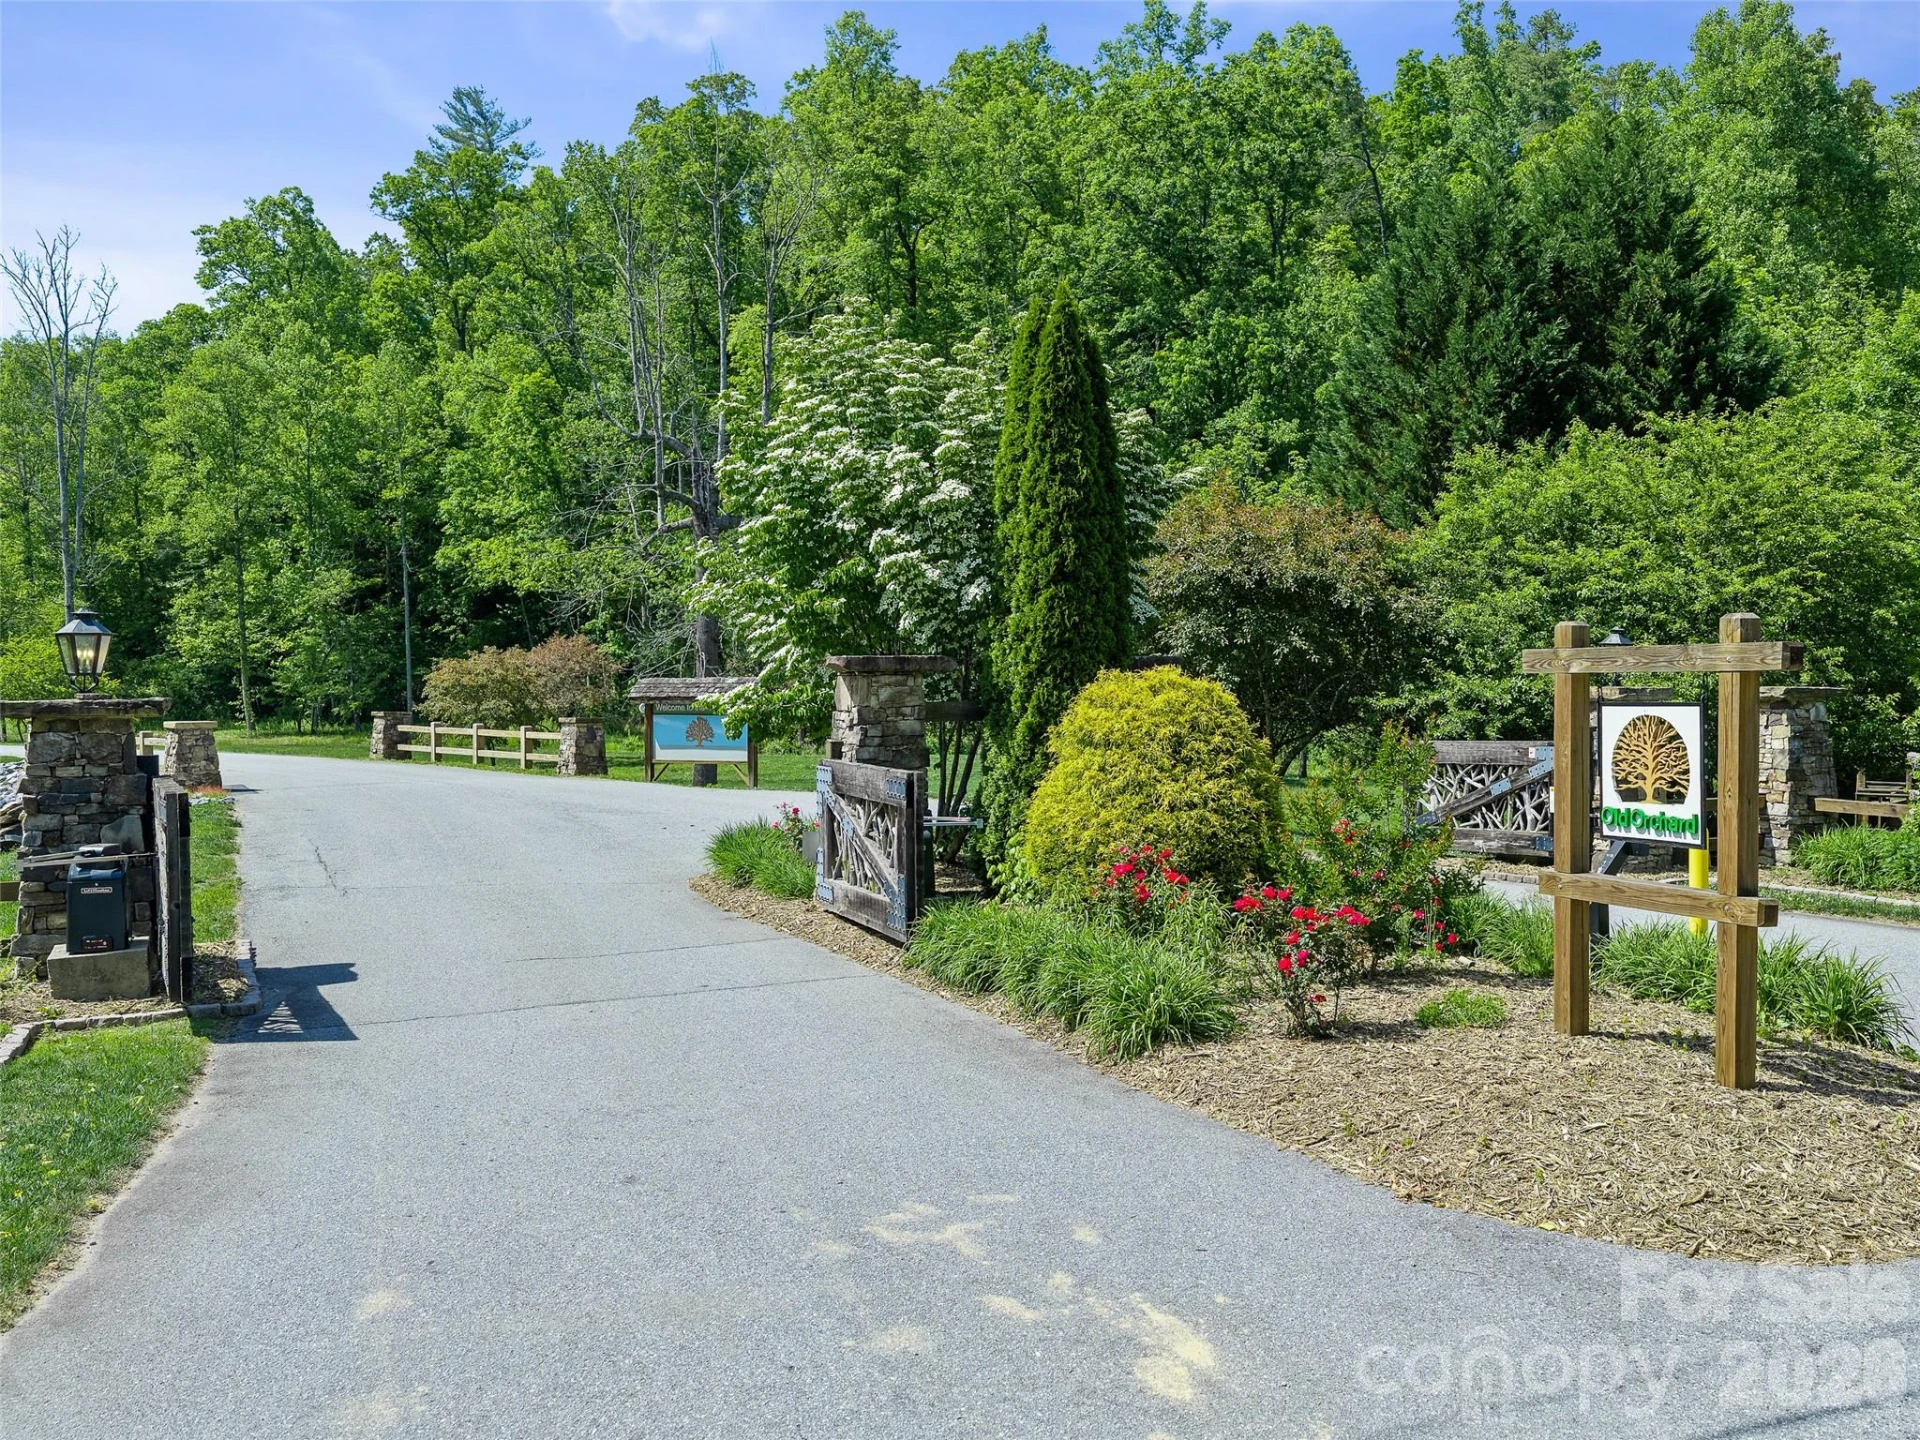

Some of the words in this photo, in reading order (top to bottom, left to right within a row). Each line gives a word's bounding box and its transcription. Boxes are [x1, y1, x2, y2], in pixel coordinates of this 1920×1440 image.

[655, 703, 685, 712] Welcome
[1602, 806, 1632, 828] Old
[1631, 808, 1699, 835] Orchard
